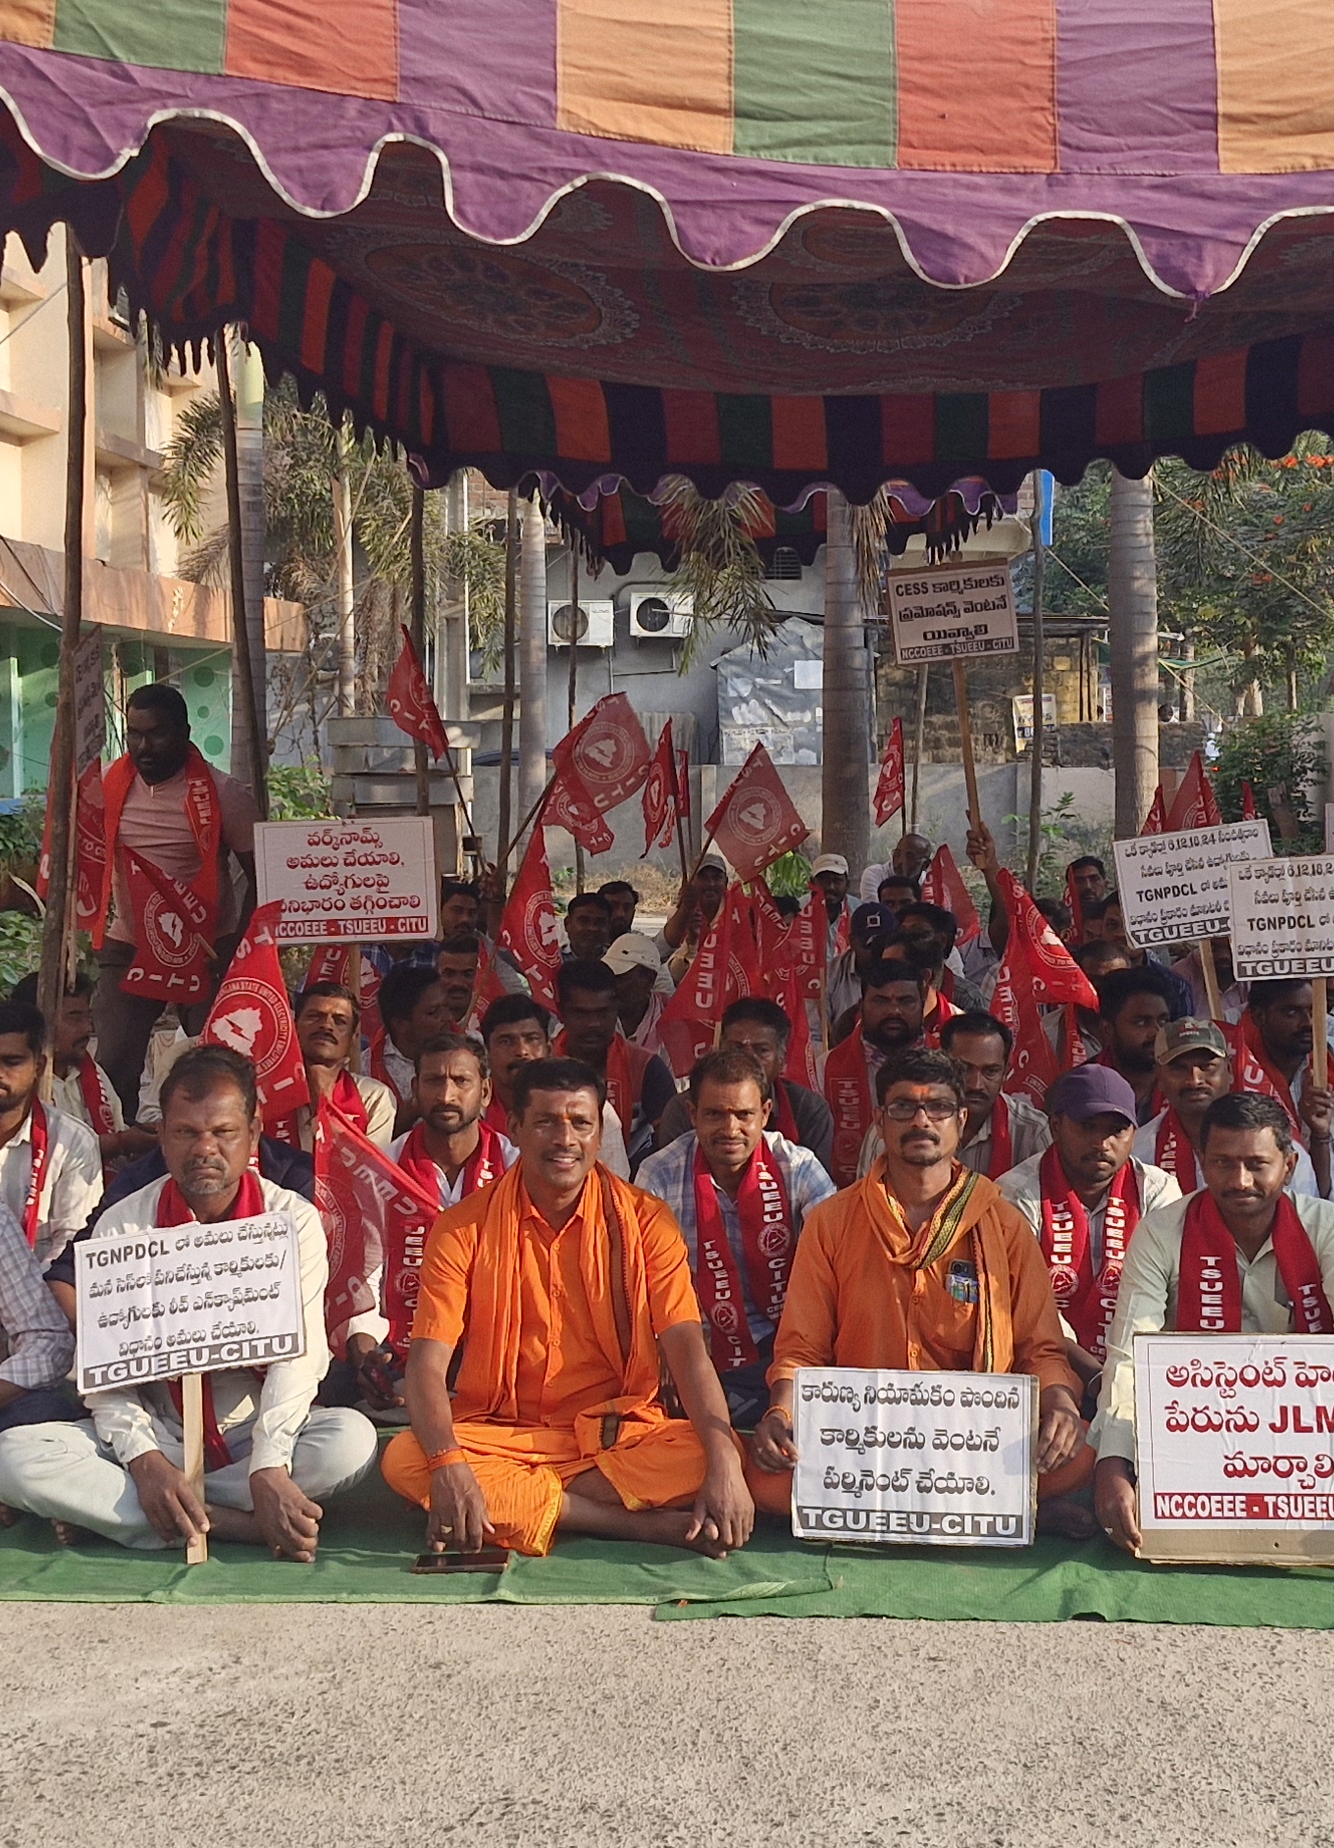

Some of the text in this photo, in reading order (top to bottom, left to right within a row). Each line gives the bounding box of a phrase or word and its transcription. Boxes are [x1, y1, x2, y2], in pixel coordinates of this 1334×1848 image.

[896, 581, 928, 597] CESS
[901, 637, 1014, 660] NCCOEEE TSUEEU CITU
[286, 853, 339, 870] అమలు
[1136, 883, 1198, 903] TGNPDCL
[275, 916, 428, 937] CCOEEE TSUEEU CITU
[1135, 918, 1231, 943] TGUEEU-
[1247, 915, 1316, 931] TGNPDCL
[85, 1239, 171, 1270] TGNPDCL
[175, 1236, 191, 1252] లో
[193, 1229, 234, 1249] అమలు
[166, 1328, 207, 1349] అమలు
[88, 1334, 293, 1386] TGUEEU-CITU
[1165, 1356, 1288, 1399] అసిస్టెంట్
[1164, 1399, 1260, 1434] పేరును
[932, 1426, 1002, 1454] వెంటనే
[1155, 1494, 1247, 1518] NCCOEEE
[801, 1508, 1018, 1536] TGUEEU-CITU
